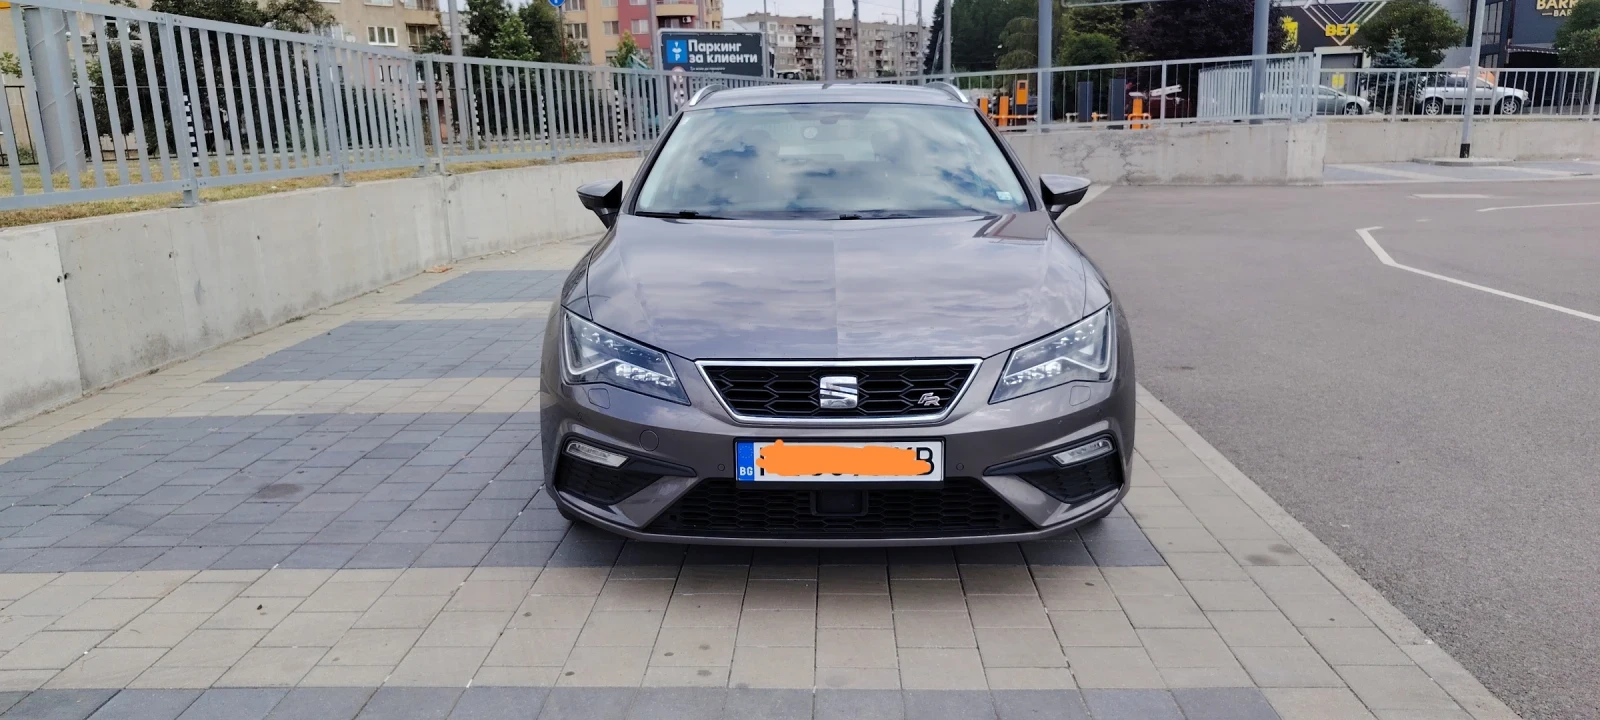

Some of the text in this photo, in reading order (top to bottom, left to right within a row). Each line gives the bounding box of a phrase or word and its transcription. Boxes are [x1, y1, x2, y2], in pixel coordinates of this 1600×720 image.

[1325, 22, 1358, 36] BET
[688, 39, 742, 54] Паркинг
[689, 53, 758, 63] за клиенти
[739, 466, 754, 476] BG
